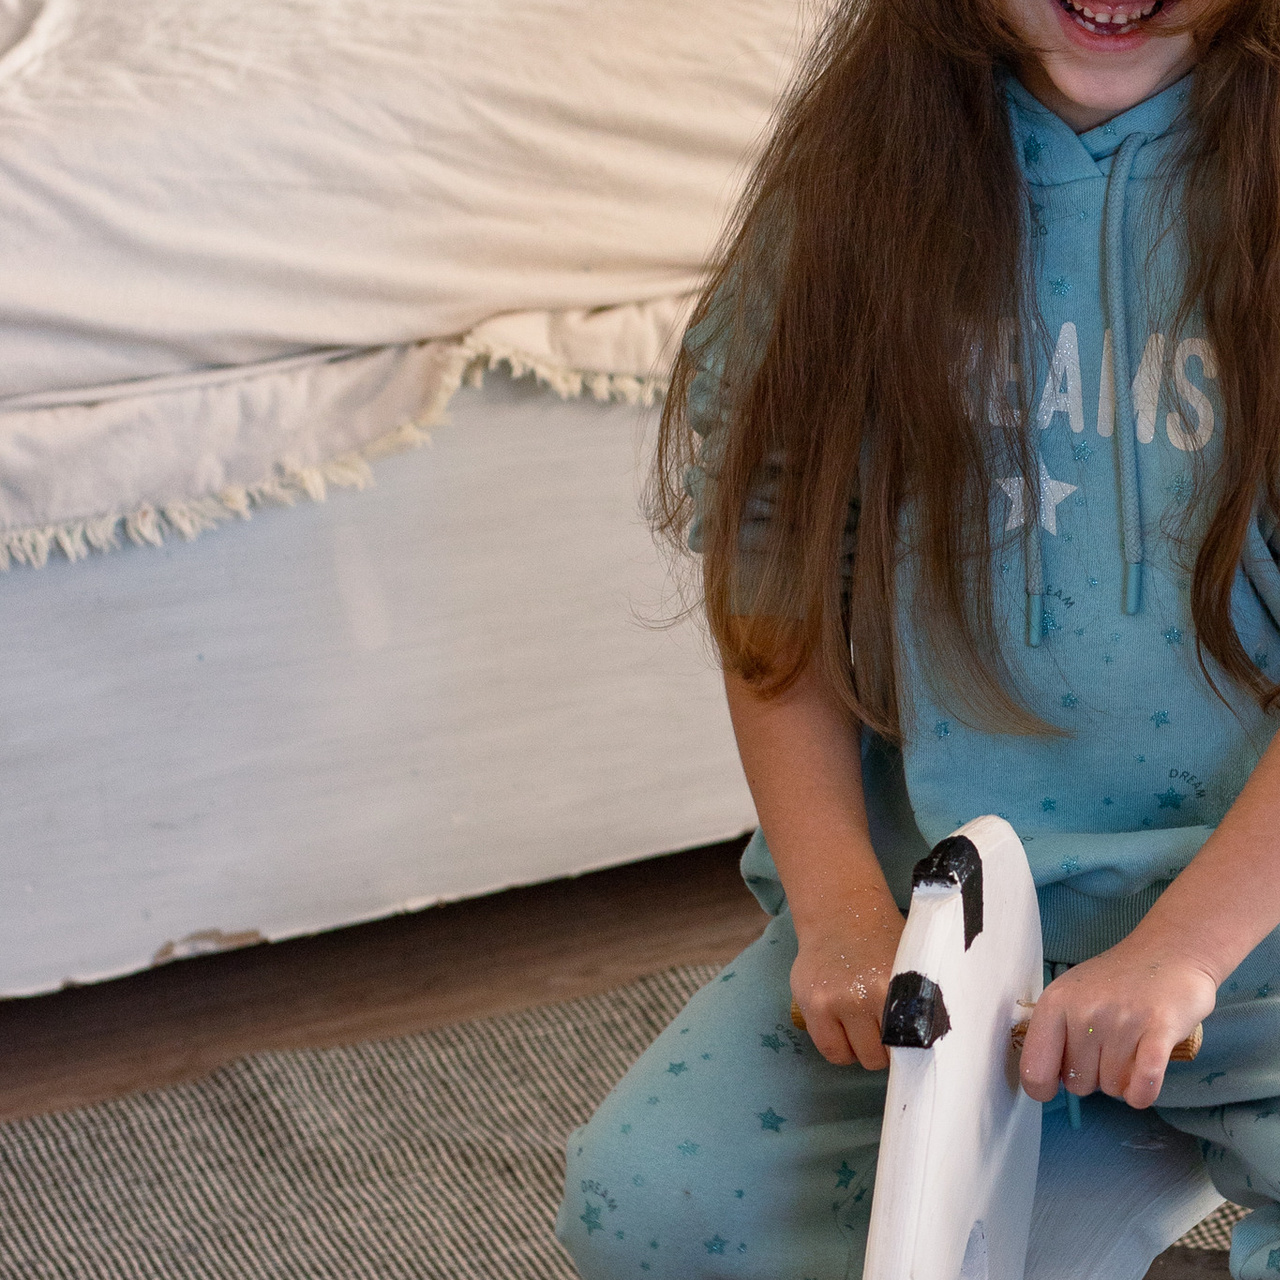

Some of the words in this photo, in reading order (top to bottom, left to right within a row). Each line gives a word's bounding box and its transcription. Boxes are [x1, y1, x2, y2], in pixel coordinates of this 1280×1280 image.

[962, 320, 1218, 452] EAMS
[1045, 584, 1075, 609] EAM
[1169, 768, 1206, 799] DREAM
